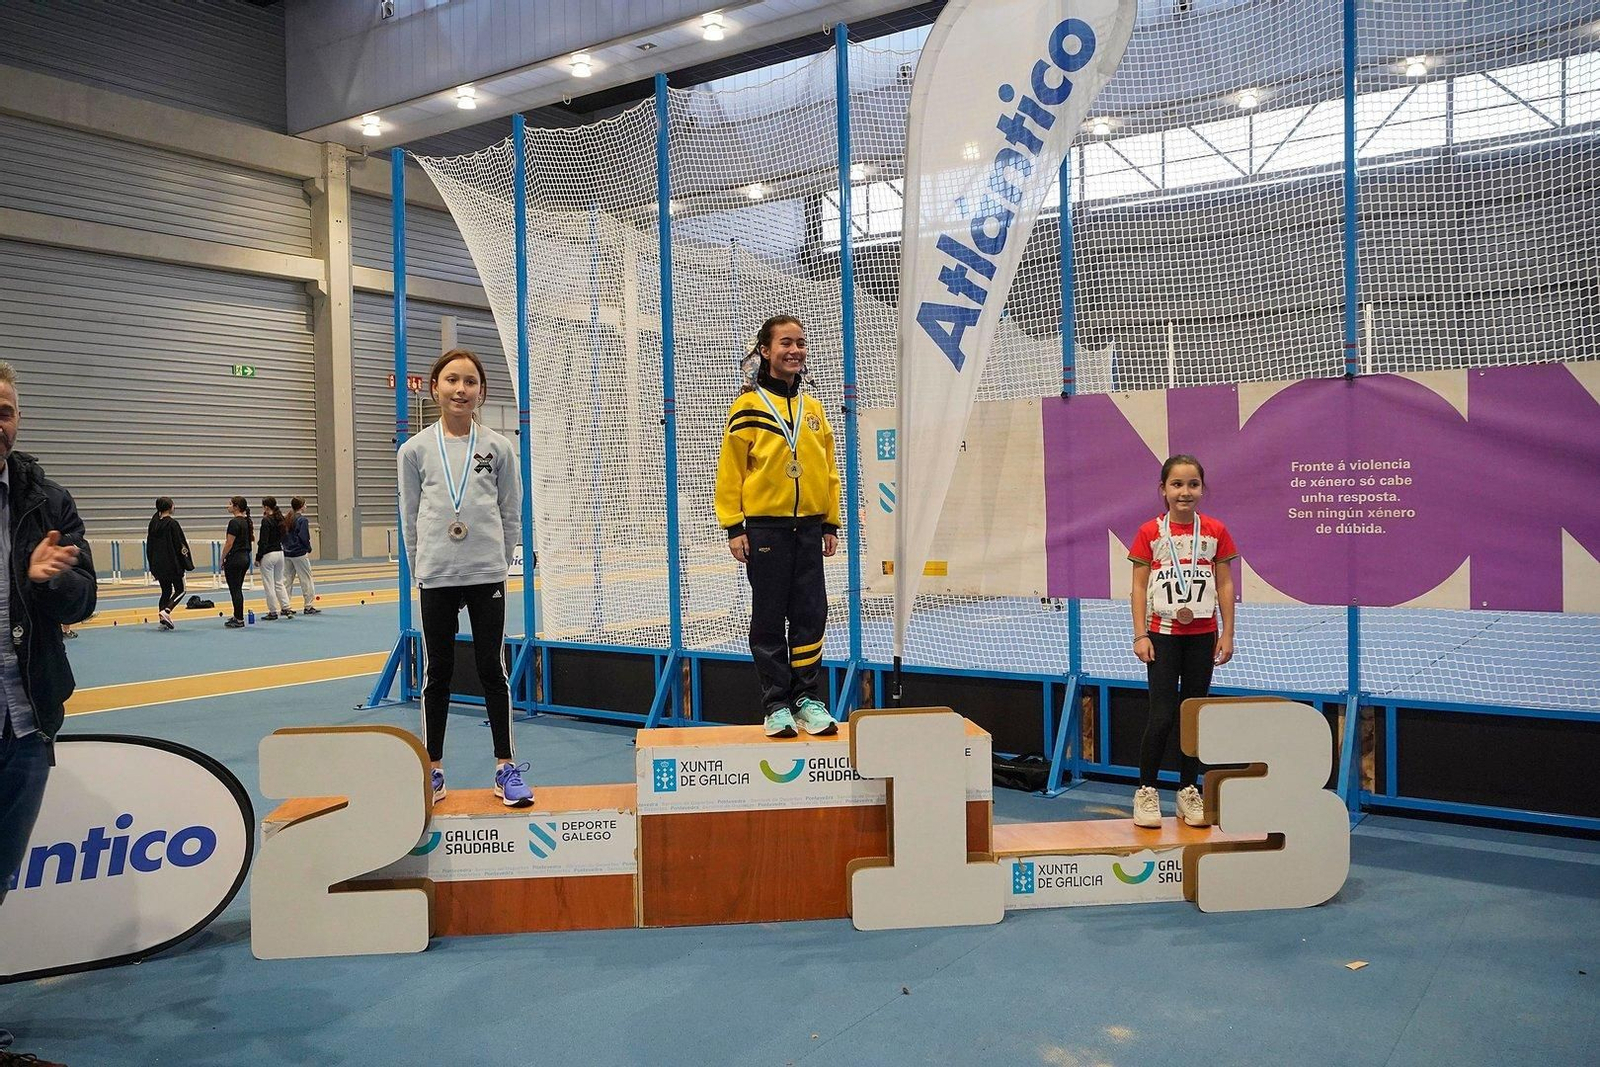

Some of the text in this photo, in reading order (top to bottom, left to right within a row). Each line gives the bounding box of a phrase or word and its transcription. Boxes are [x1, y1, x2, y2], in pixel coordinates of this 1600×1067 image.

[915, 18, 1097, 373] Atlántico
[1291, 458, 1411, 472] Fronte á violencia
[1290, 474, 1413, 488] de xénero só cabe
[1301, 491, 1401, 504] unha resposta.
[1288, 506, 1416, 520] Sen ningún xénero
[1315, 523, 1386, 534] de dúbida.
[680, 760, 723, 773] XUNTA
[808, 757, 853, 770] GALICI
[680, 773, 750, 787] DE GALICIA
[1191, 698, 1350, 914] 3
[561, 820, 617, 831] DEPORTE
[445, 829, 498, 842] GALICIA
[562, 831, 612, 842] GALEGO
[250, 727, 431, 960] 2
[445, 841, 515, 855] SAUDABLE
[1038, 863, 1078, 876] XUNTA
[1038, 874, 1103, 888] DE GALICIA
